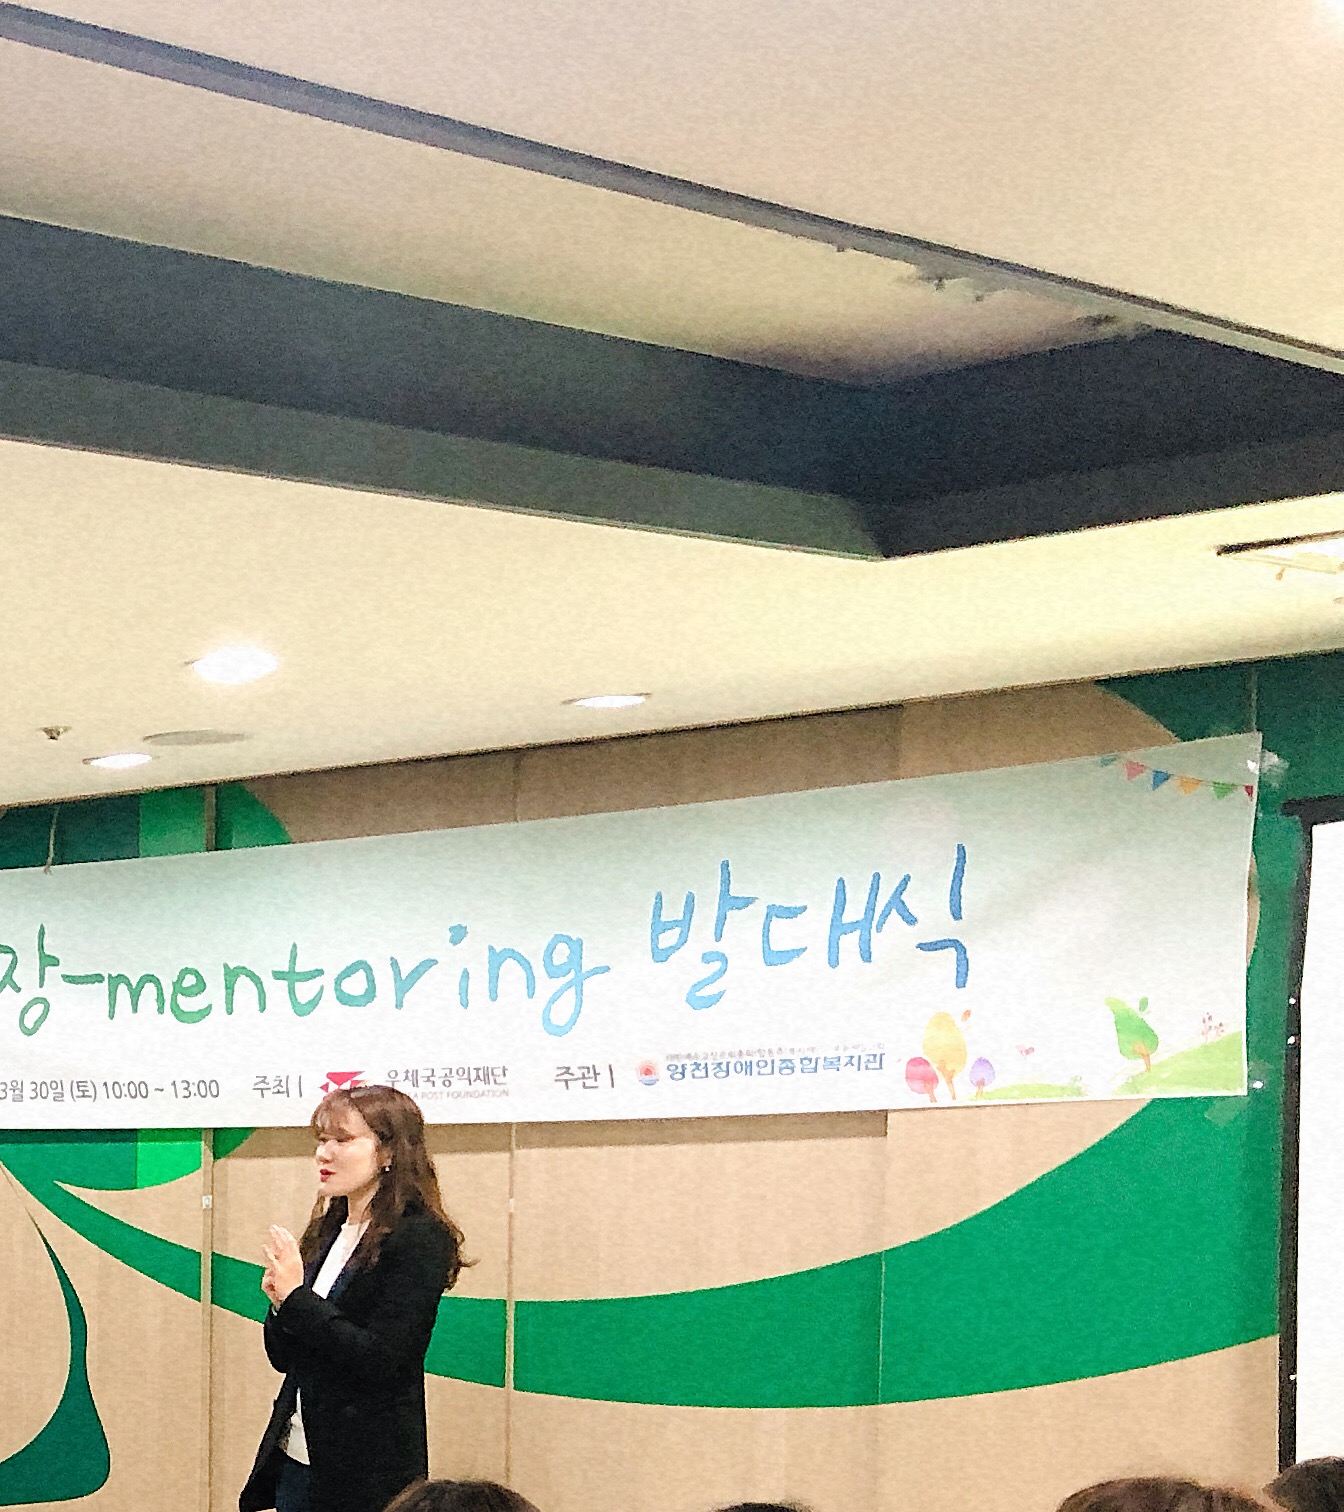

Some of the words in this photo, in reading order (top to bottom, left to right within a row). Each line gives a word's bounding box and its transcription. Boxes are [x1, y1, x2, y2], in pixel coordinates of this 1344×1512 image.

[651, 842, 968, 1009] 발대식
[553, 1063, 602, 1090] 주관
[666, 1052, 886, 1082] 양천장애인종합복지관
[29, 1079, 65, 1103] 30일
[69, 1079, 98, 1102] (토)
[102, 1080, 149, 1100] 10:00
[170, 1079, 220, 1099] 13:00
[251, 1074, 290, 1098] 주최
